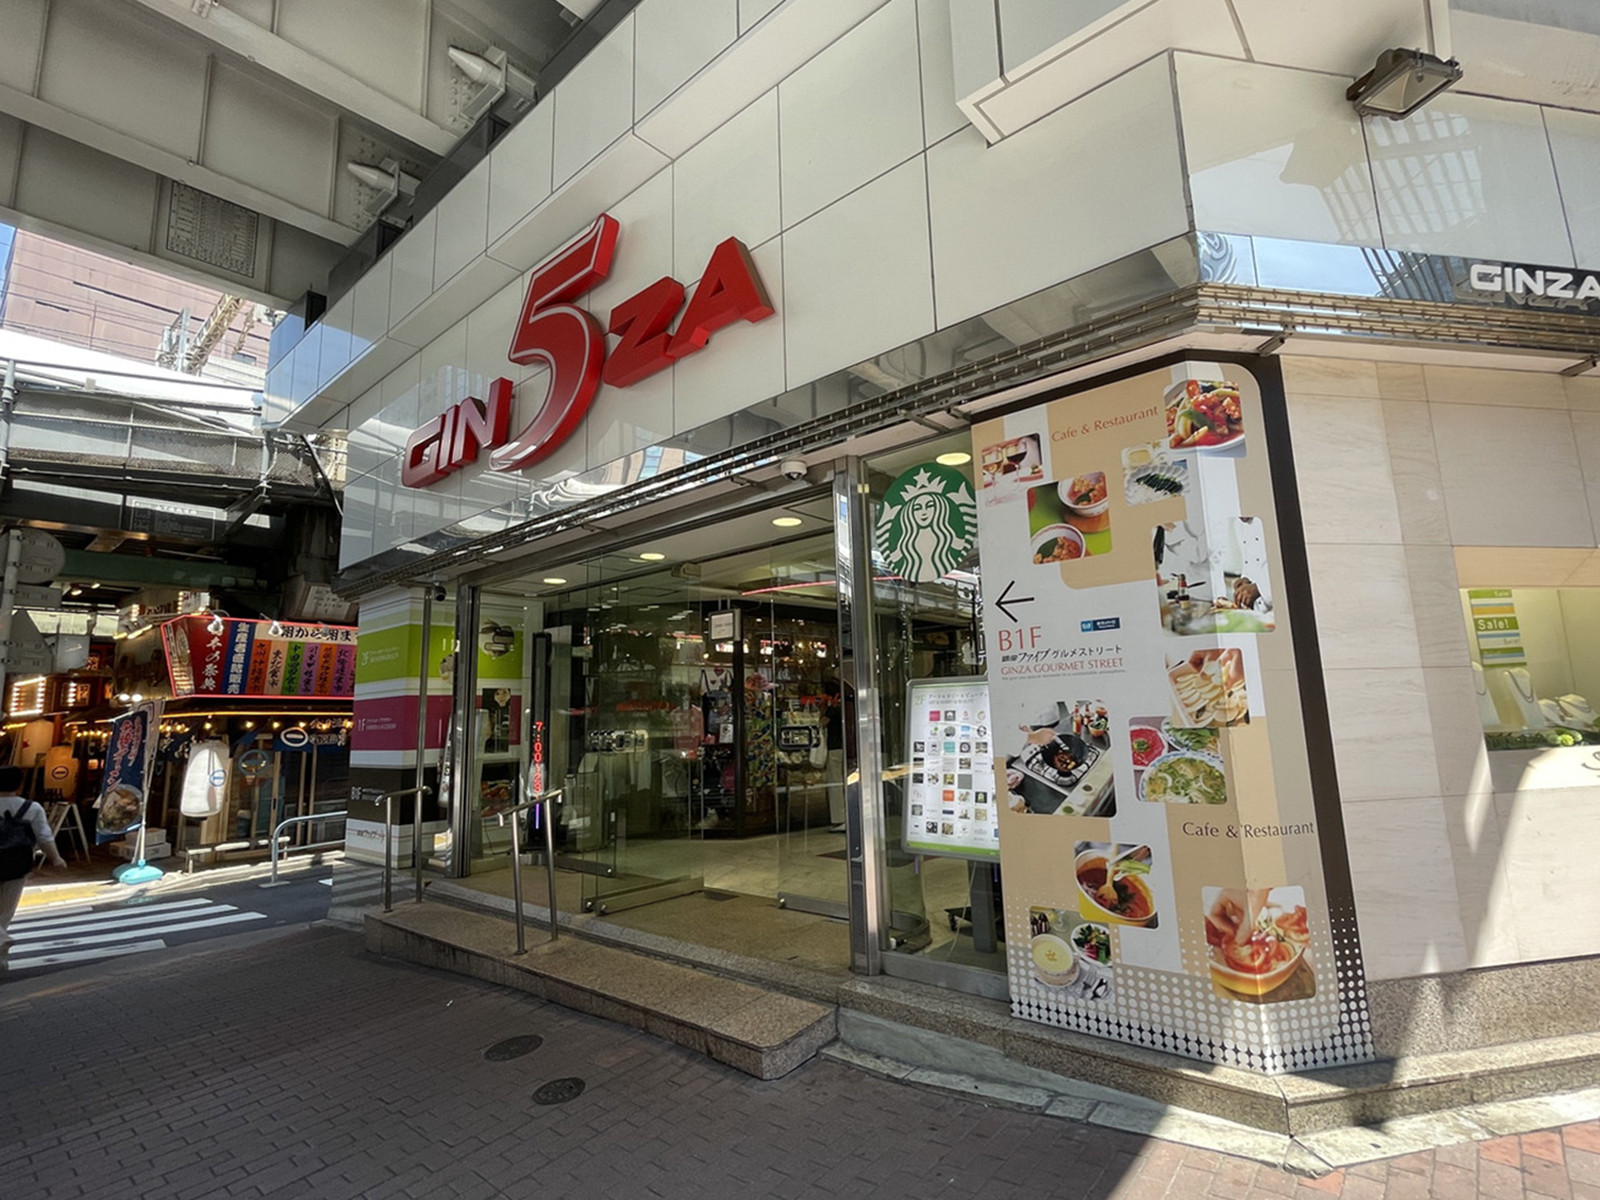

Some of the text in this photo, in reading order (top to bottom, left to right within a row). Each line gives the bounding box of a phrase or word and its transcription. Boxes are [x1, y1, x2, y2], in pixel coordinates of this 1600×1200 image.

[1470, 264, 1600, 299] GINZA
[1051, 406, 1159, 443] Cafe & Restaurant
[1477, 619, 1509, 631] Sale!
[998, 626, 1042, 652] B1F
[1000, 658, 1124, 675] GINZA GOURMET STREET
[1182, 821, 1315, 838] Cafe & Restaurant
